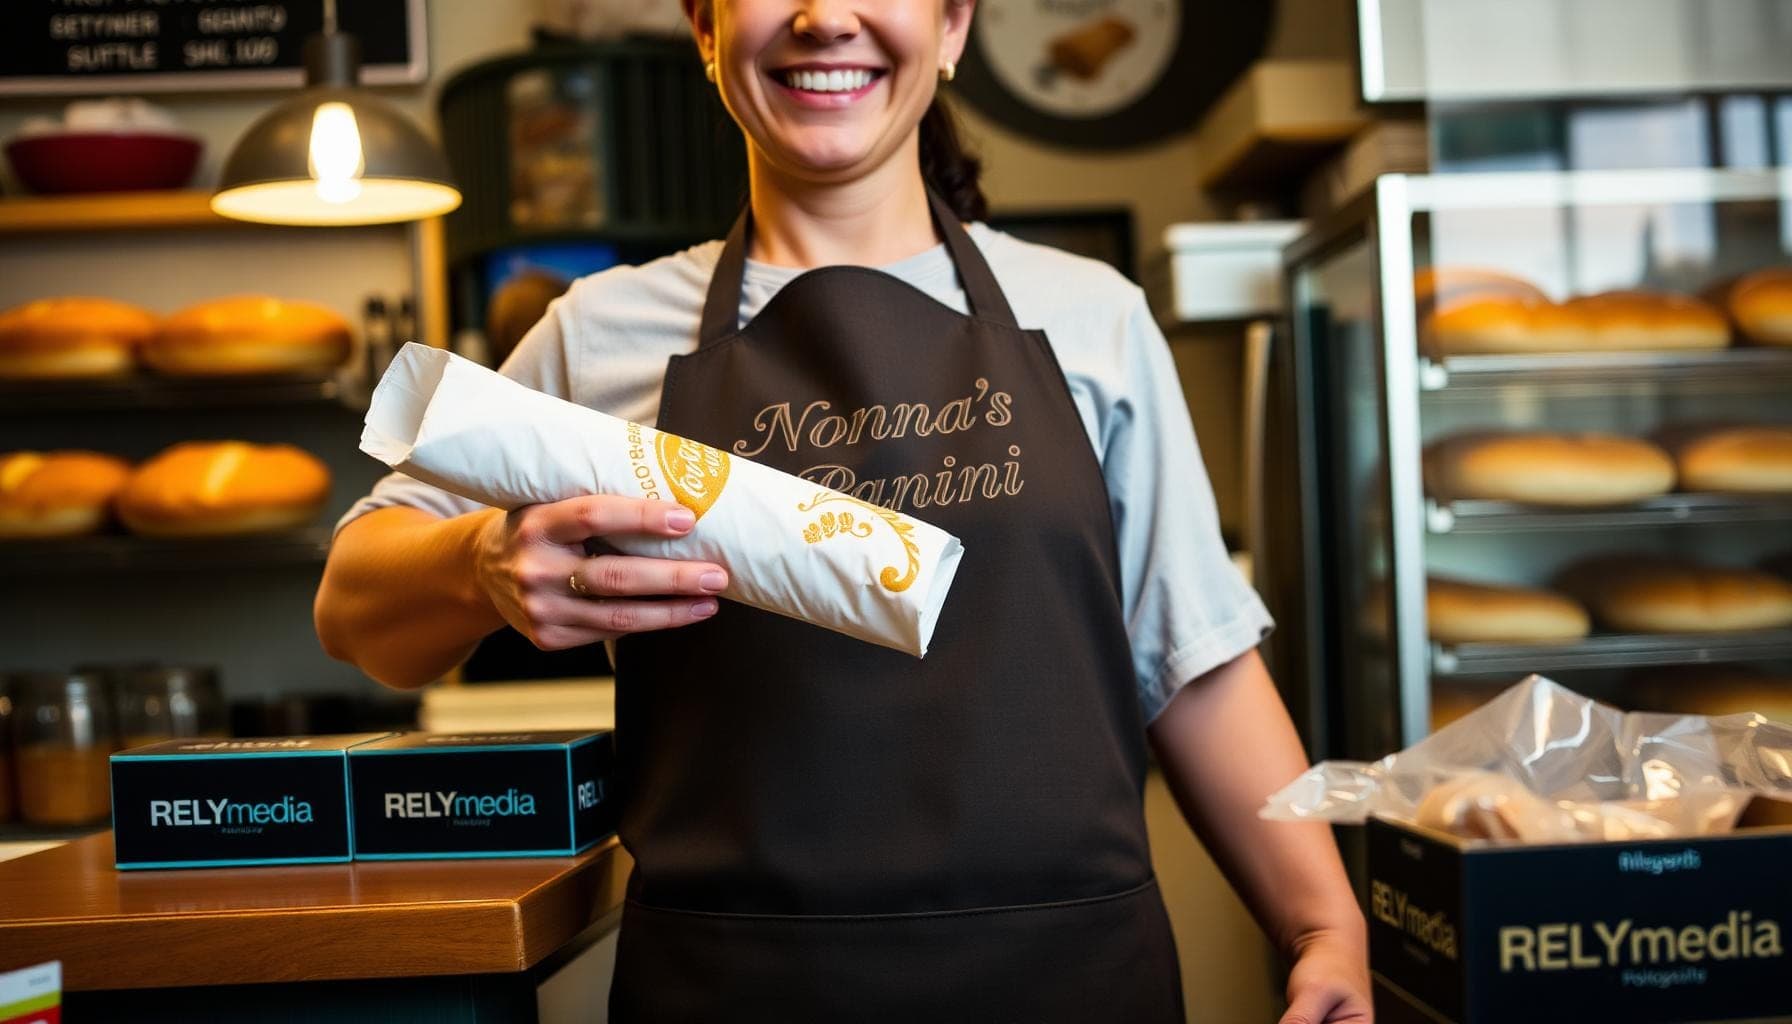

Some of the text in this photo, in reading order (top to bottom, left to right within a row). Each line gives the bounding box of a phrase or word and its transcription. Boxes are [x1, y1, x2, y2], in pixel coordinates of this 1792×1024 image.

[733, 378, 1013, 457] Nonna's
[150, 795, 313, 826] RELYmedia
[384, 788, 536, 818] RELYmedia
[1500, 910, 1782, 971] RELYmedia
